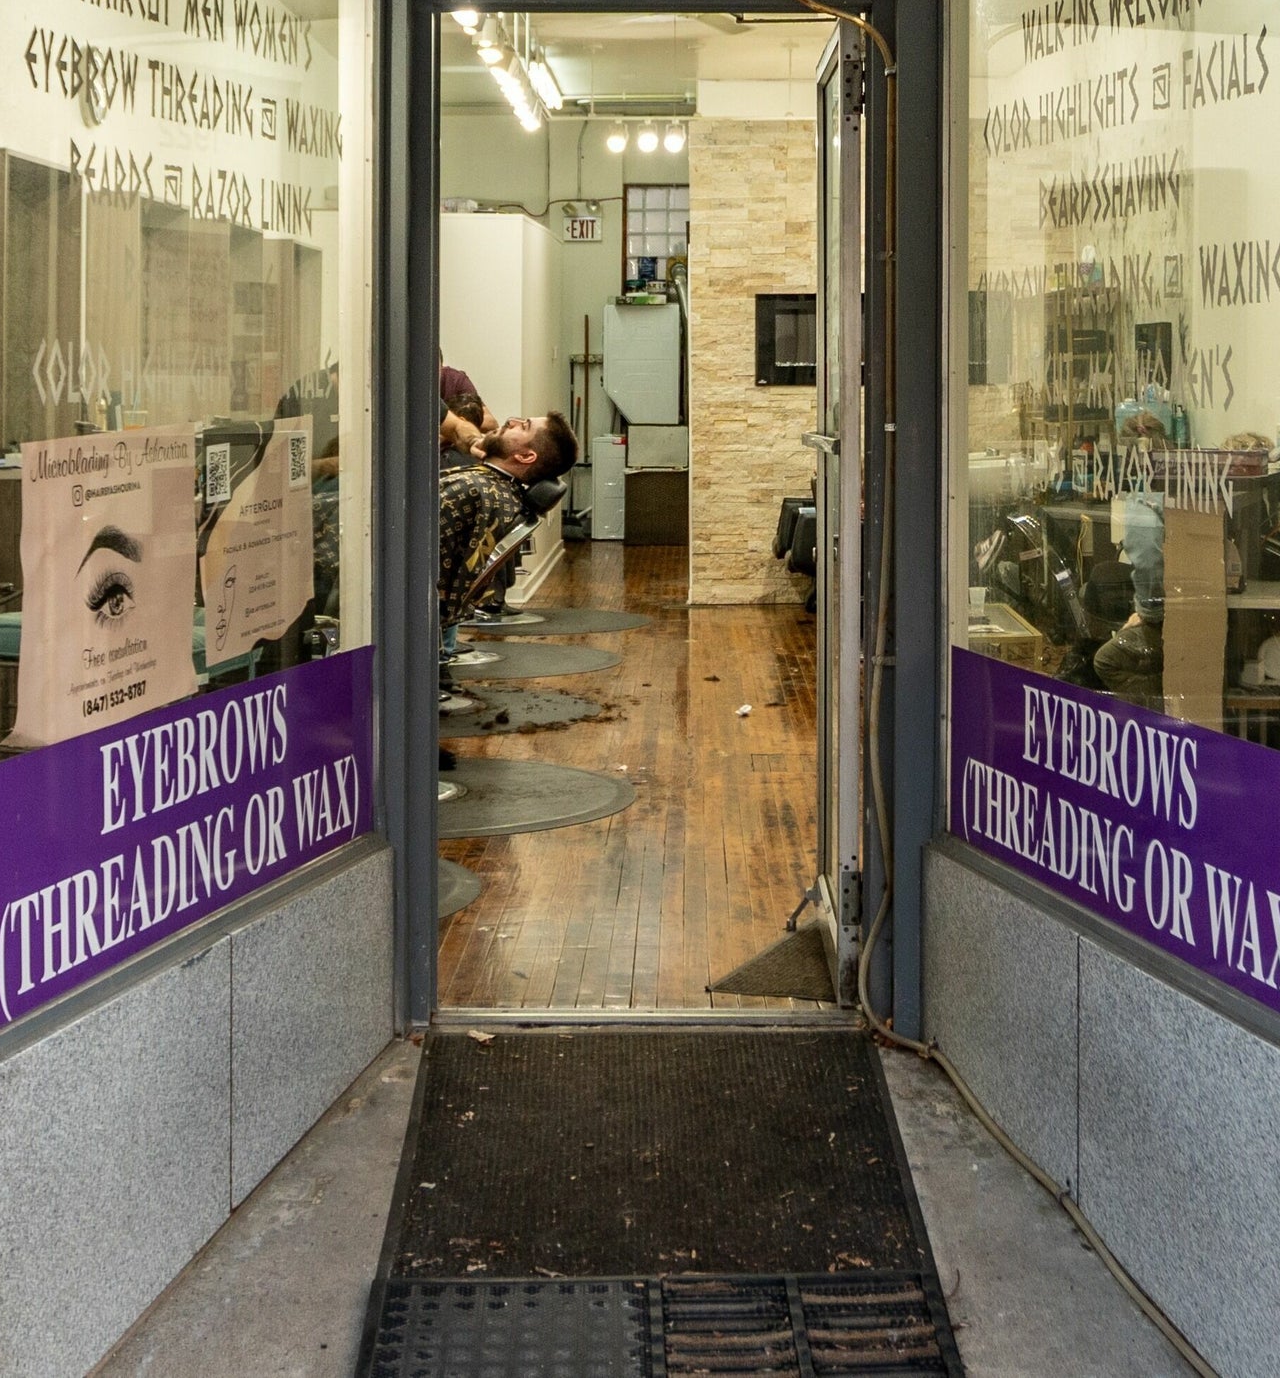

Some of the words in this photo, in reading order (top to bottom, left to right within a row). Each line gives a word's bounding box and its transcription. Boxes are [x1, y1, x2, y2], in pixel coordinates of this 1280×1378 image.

[24, 25, 138, 115] EYEBROW
[148, 59, 254, 140] THREADING
[285, 98, 343, 162] WAXING
[984, 96, 1032, 157] COLOR
[1039, 62, 1140, 147] HIGHLIGHTS
[1182, 24, 1269, 110] FACIALS
[192, 162, 252, 230] RAZOR
[261, 178, 313, 237] LINING
[571, 219, 596, 239] EXIT
[1039, 148, 1181, 230] BEARDSSHAVING
[32, 338, 113, 406] COLOR
[30, 446, 110, 482] Microblading
[113, 441, 132, 475] By
[1161, 438, 1233, 519] LINING
[81, 647, 106, 670] Free
[82, 694, 109, 717] (847)
[110, 680, 147, 707] 532-8787
[100, 682, 288, 836] EYEBROWS
[1022, 683, 1198, 830] EYEBROWS
[244, 786, 288, 876] OR
[293, 754, 360, 854] WAX)
[962, 756, 1136, 914] (THREADING
[1145, 838, 1196, 948] OR
